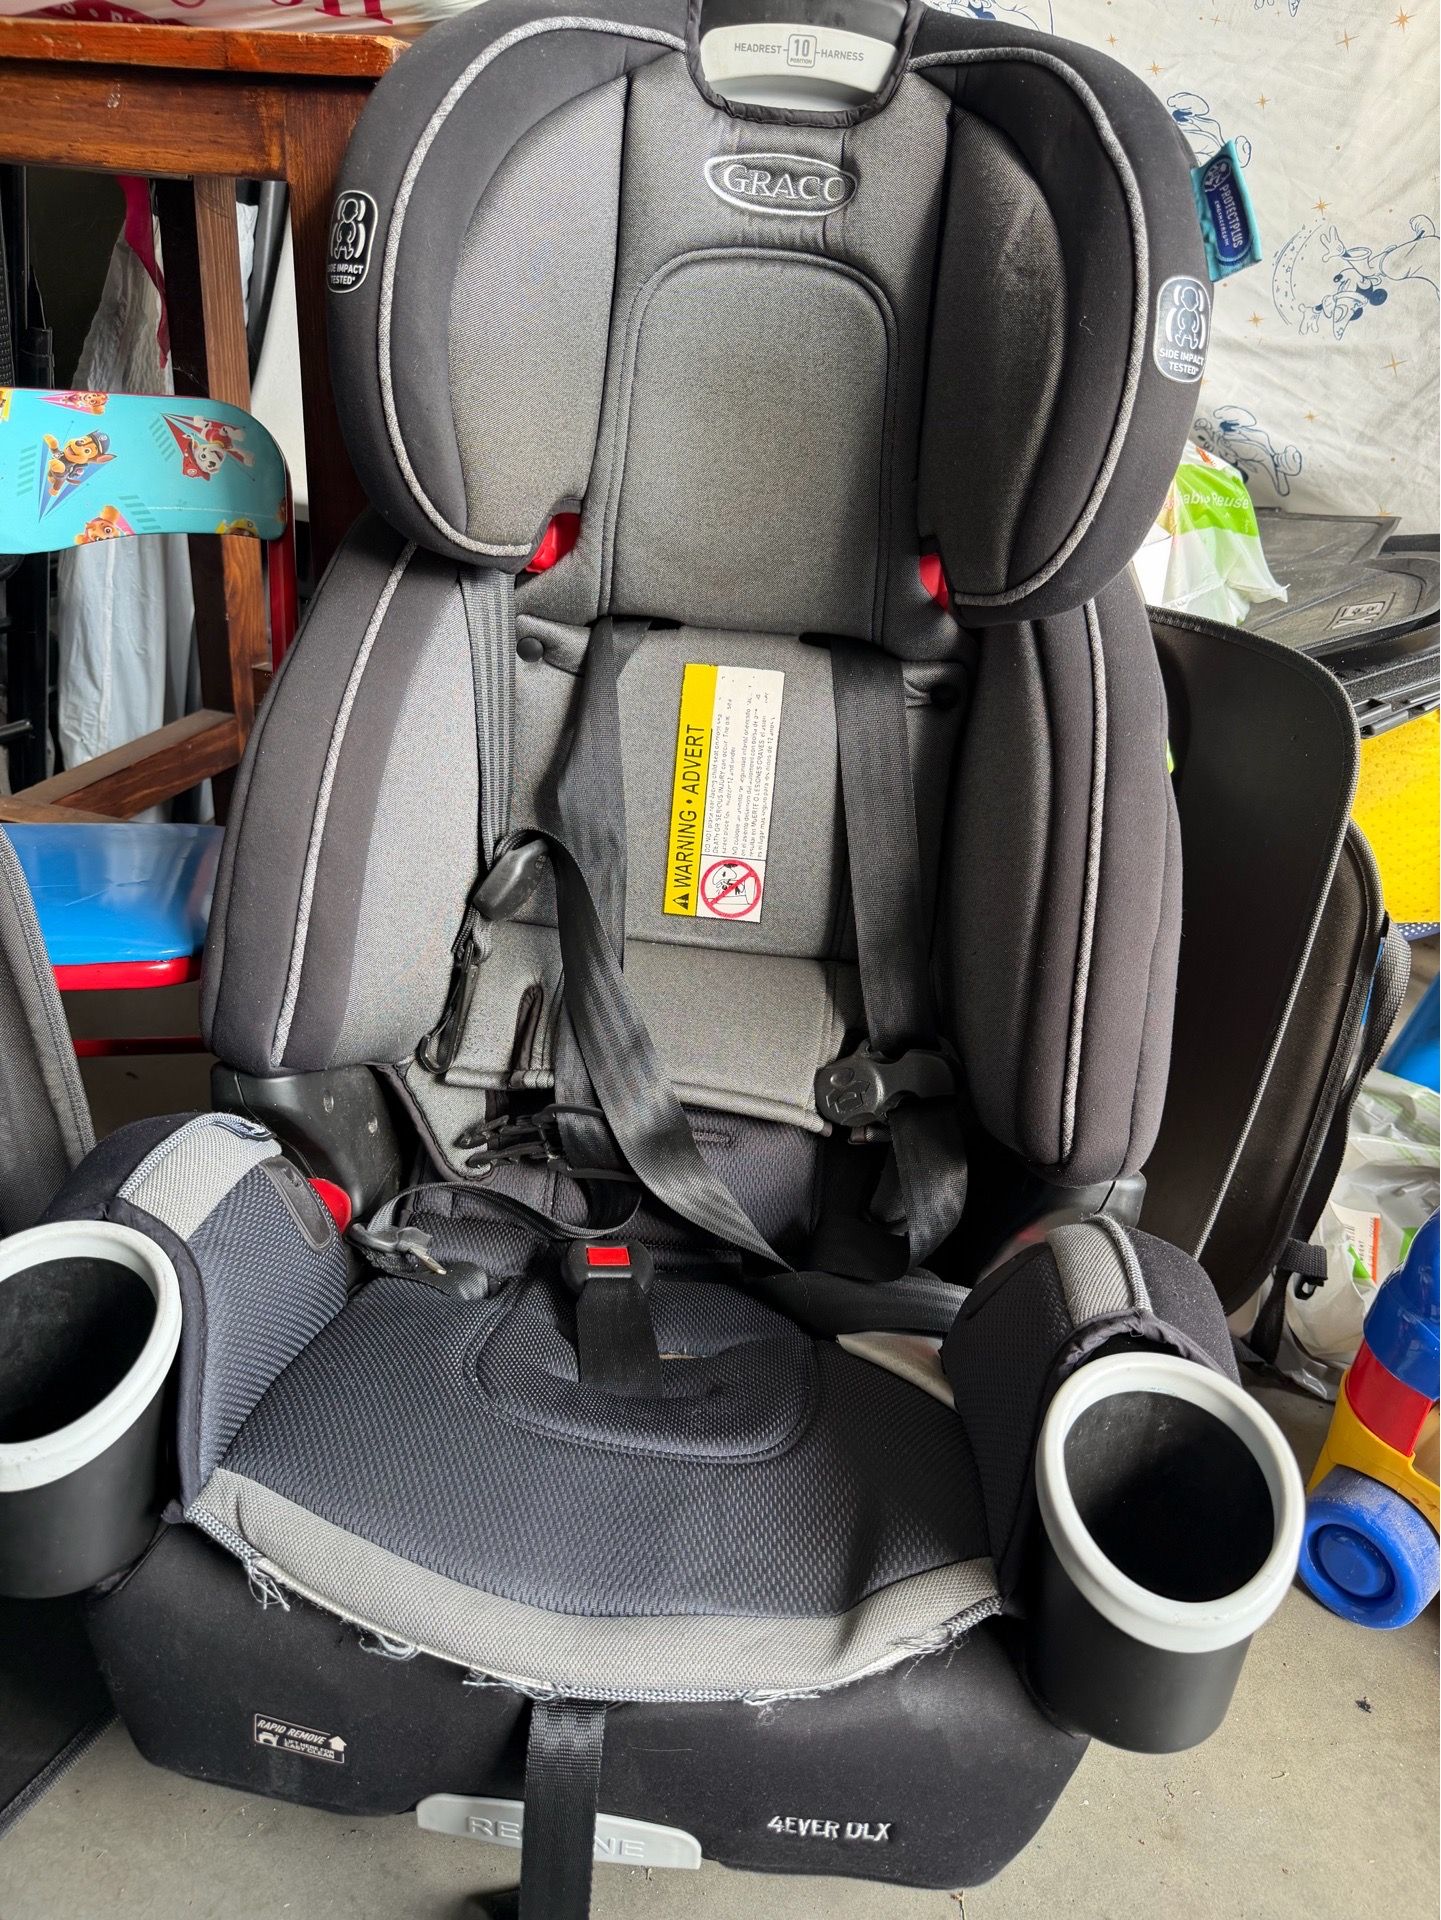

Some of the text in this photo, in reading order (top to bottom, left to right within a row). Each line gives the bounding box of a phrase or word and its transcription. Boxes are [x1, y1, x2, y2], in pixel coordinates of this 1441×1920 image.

[734, 43, 782, 54] HEADREST
[794, 39, 810, 57] 10
[820, 50, 864, 61] HARNESS
[723, 164, 846, 201] GRACO
[1219, 184, 1243, 248] PROTECTPLUS
[337, 264, 363, 274] IMPACT
[1160, 348, 1204, 365] SIDE IMPACT
[674, 810, 697, 888] WARNING
[257, 1719, 326, 1744] RAPID REMOVE
[466, 1815, 645, 1858] RENE
[767, 1815, 892, 1841] 4EVER DLX
